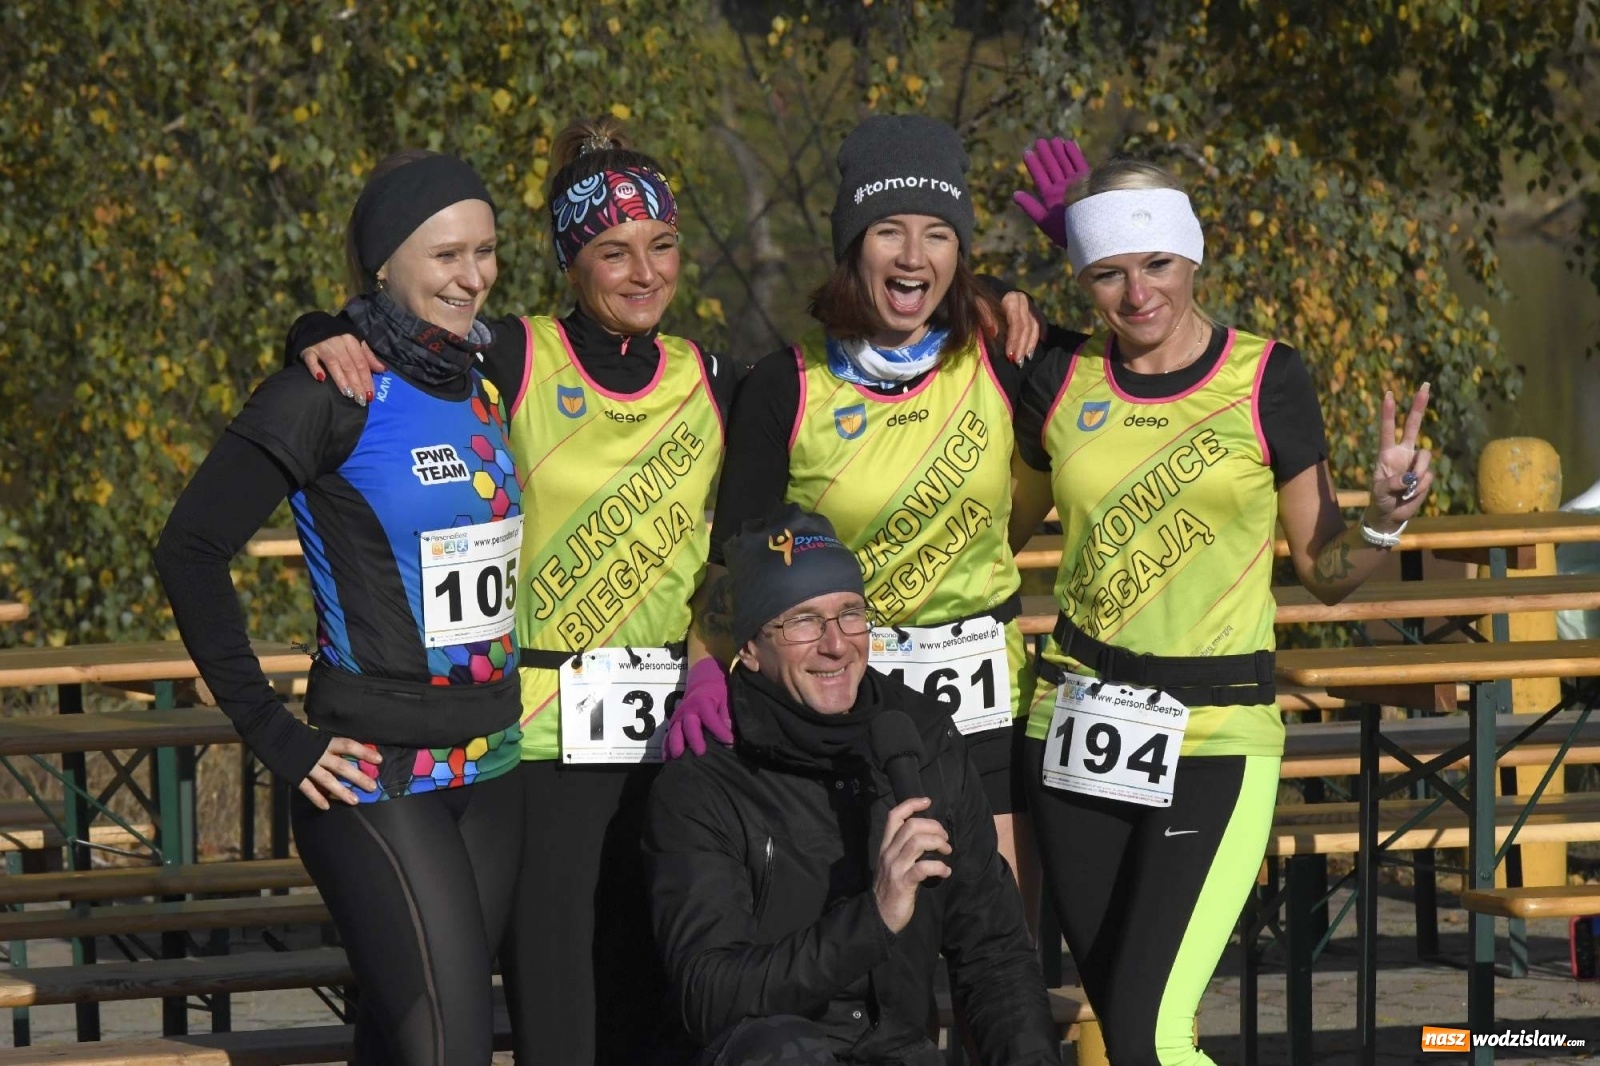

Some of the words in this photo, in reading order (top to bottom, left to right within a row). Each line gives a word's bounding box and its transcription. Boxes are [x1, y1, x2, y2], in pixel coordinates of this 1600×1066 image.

[854, 176, 961, 204] #tomorrow
[604, 409, 647, 423] deep
[886, 409, 929, 427] deep
[1124, 414, 1169, 429] deep
[415, 448, 457, 465] PWR
[417, 464, 467, 481] TEAM
[530, 421, 704, 620] JEJKOWICE
[1063, 428, 1228, 619] JEJKOWICE
[435, 557, 517, 622] 105
[920, 628, 999, 649] www.personalbest.pl
[1091, 693, 1184, 717] www.personalbest.pl
[1055, 716, 1169, 784] 194
